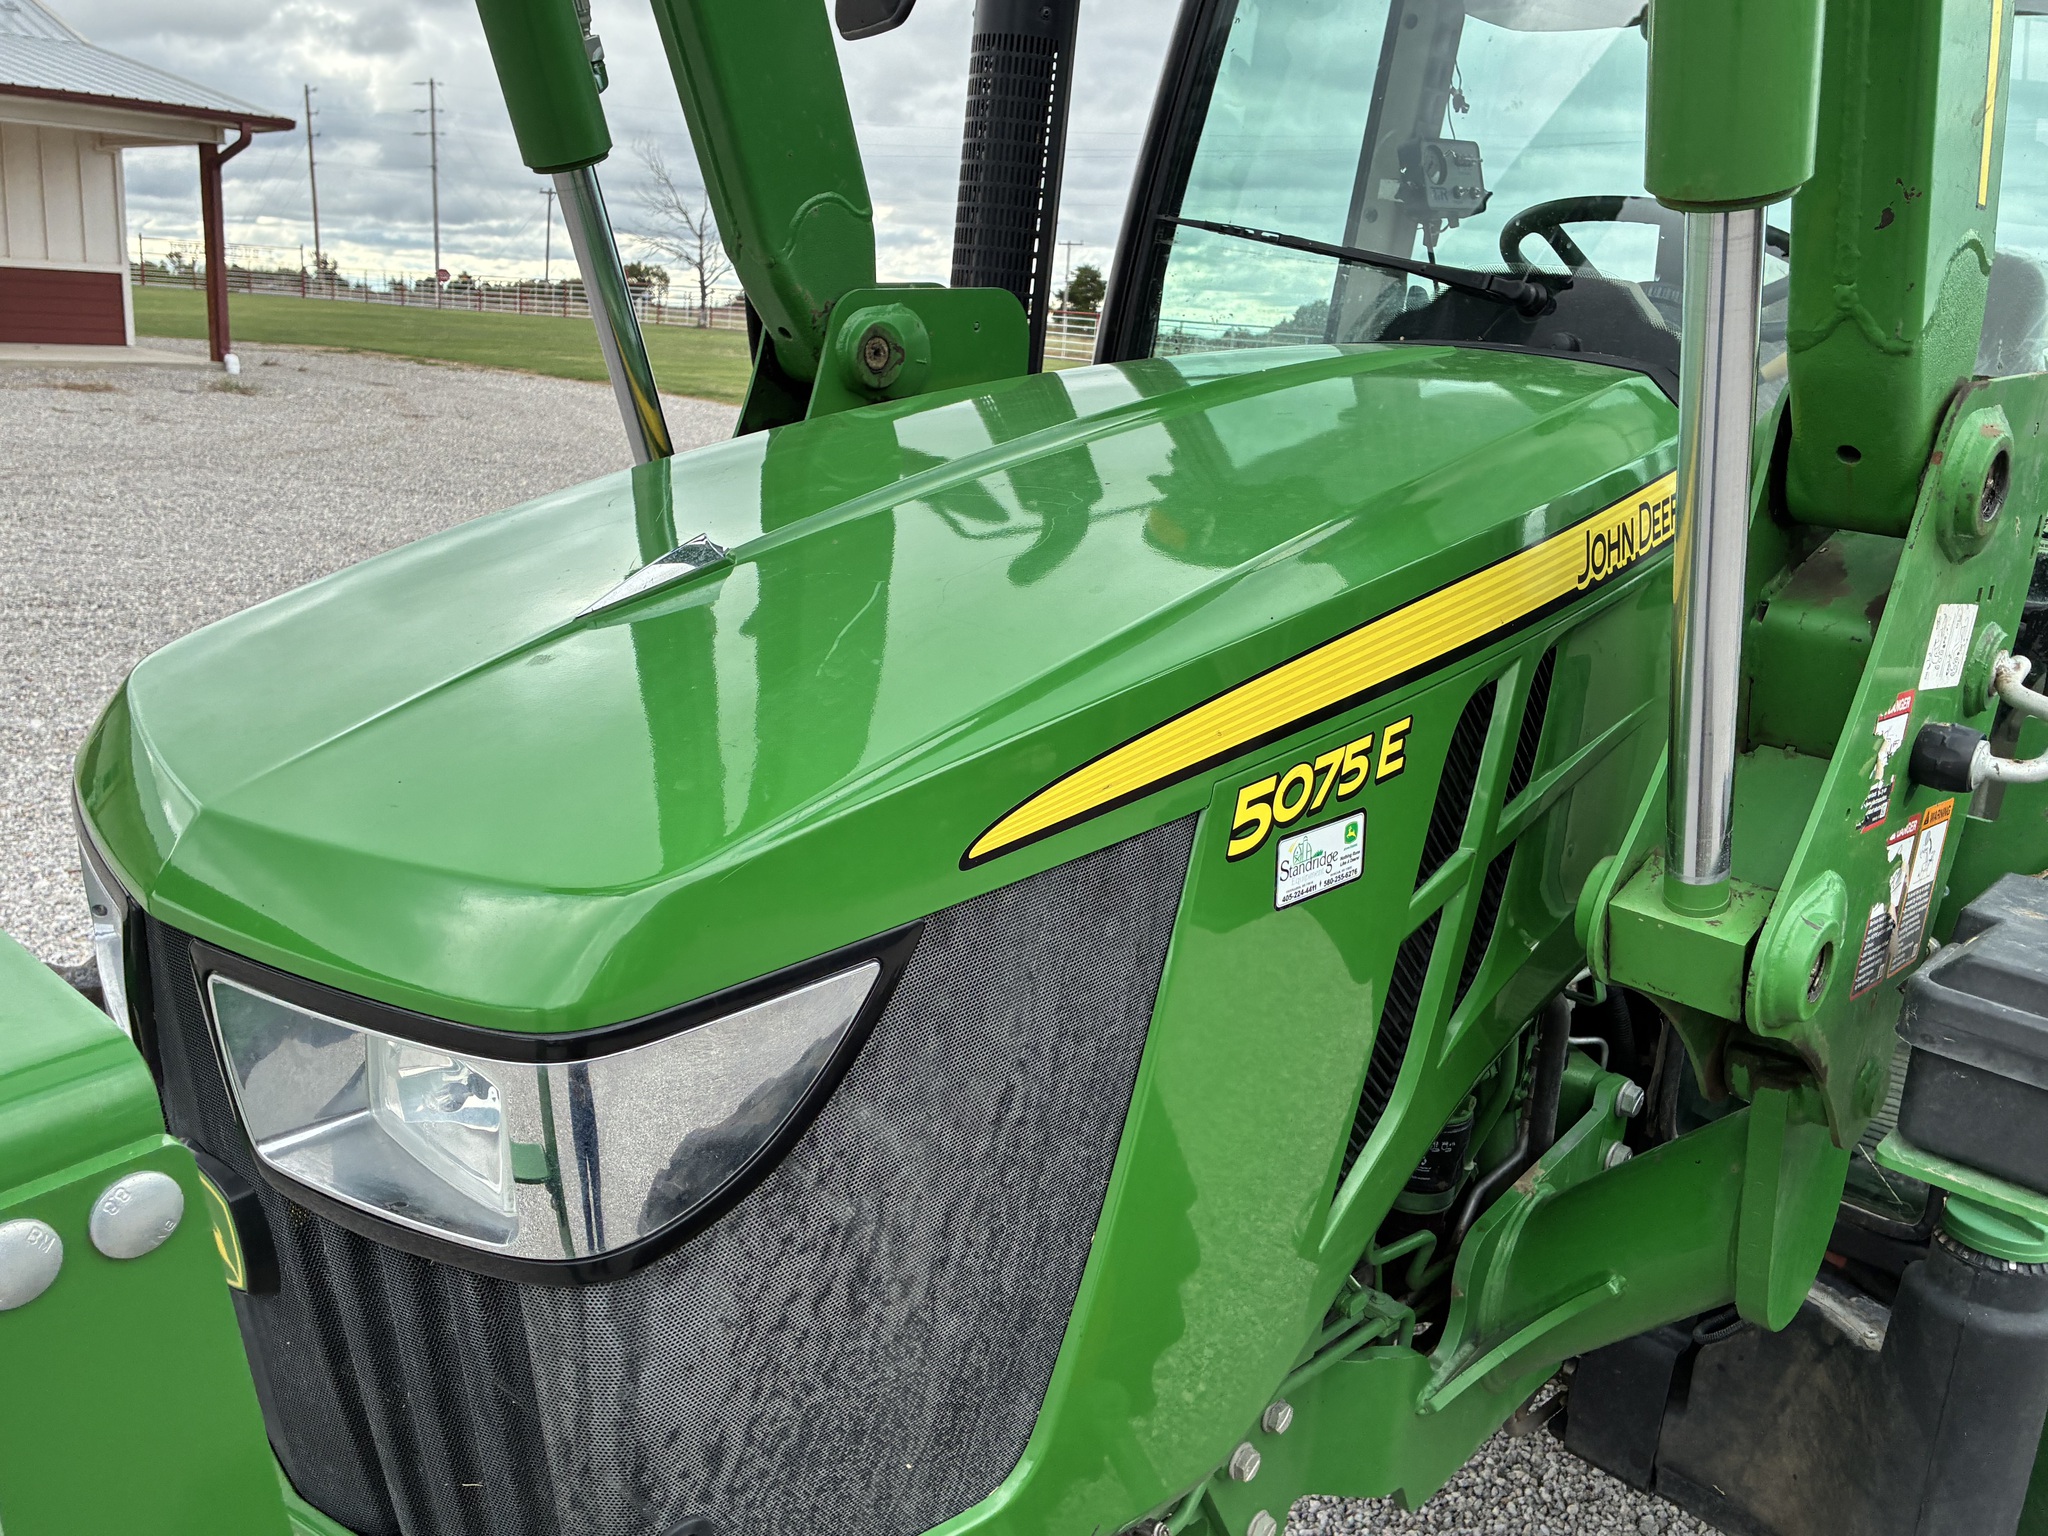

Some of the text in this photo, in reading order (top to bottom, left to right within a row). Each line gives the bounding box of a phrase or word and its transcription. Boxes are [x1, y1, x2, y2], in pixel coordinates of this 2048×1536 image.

[1577, 494, 1677, 585] JOHN DEER
[1929, 806, 1952, 824] WARNING
[1280, 850, 1339, 882] Standridge
